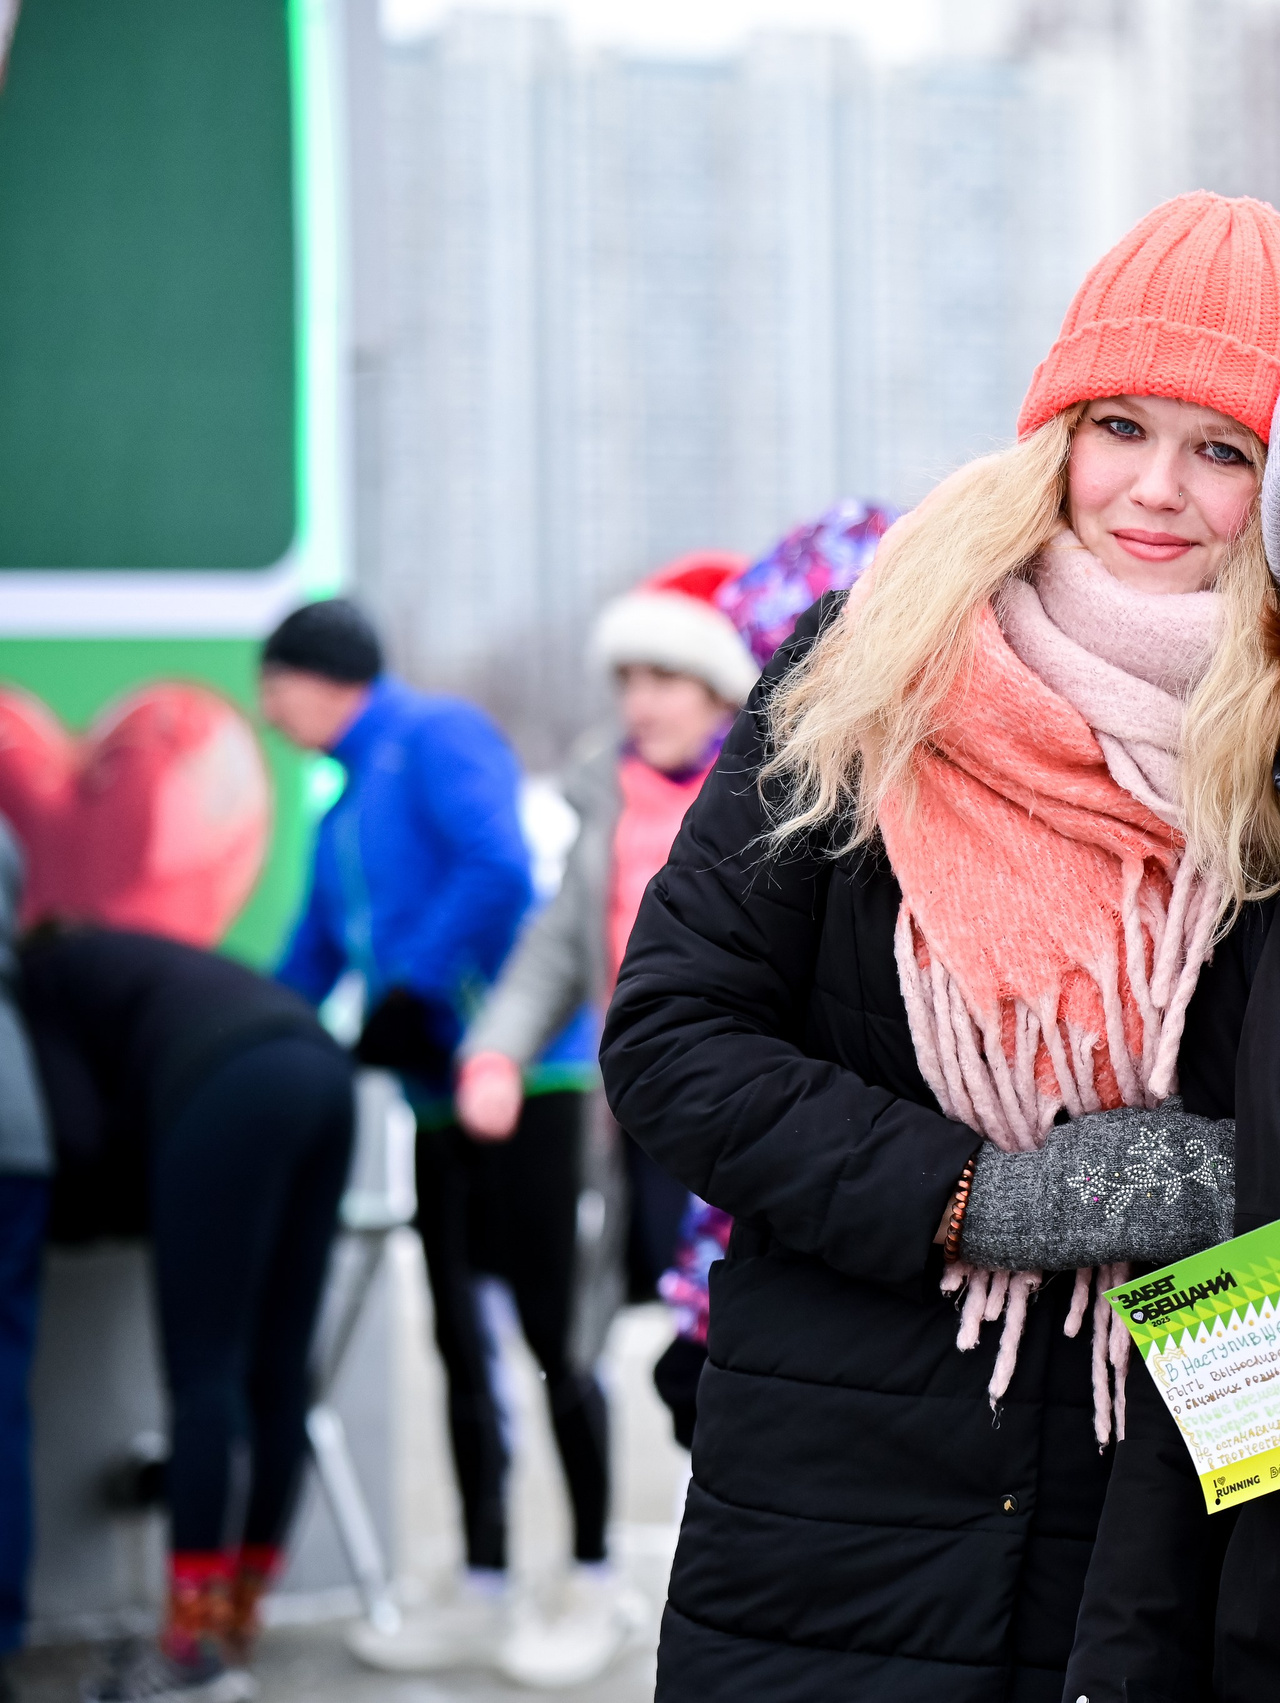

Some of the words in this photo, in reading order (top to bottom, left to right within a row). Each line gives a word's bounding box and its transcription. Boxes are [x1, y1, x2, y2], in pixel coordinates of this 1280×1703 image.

[1118, 1274, 1176, 1309] ЗАБЕГ
[1130, 1267, 1238, 1324] ОБЕЩАНИЙ
[1151, 1315, 1171, 1327] 2025
[1165, 1362, 1178, 1382] В
[1216, 1475, 1261, 1499] RUNNING
